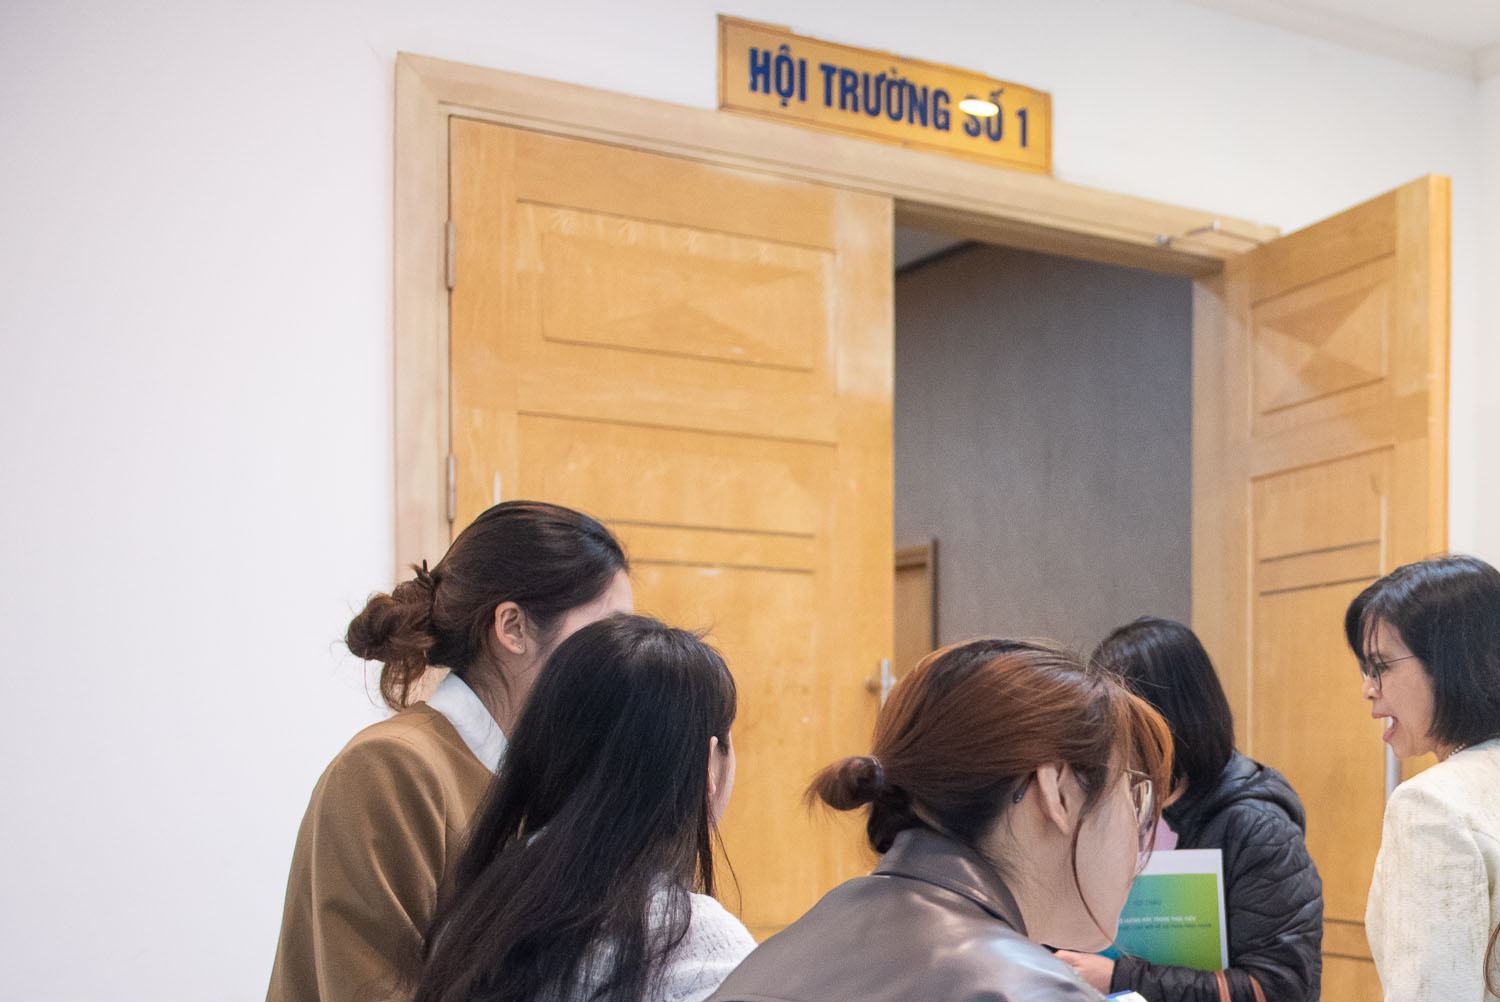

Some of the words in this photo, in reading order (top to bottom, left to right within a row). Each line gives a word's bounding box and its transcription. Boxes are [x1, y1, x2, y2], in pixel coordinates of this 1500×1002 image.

[749, 44, 807, 108] HỘI
[819, 63, 951, 132] TRƯỜNG
[1016, 108, 1028, 148] 1
